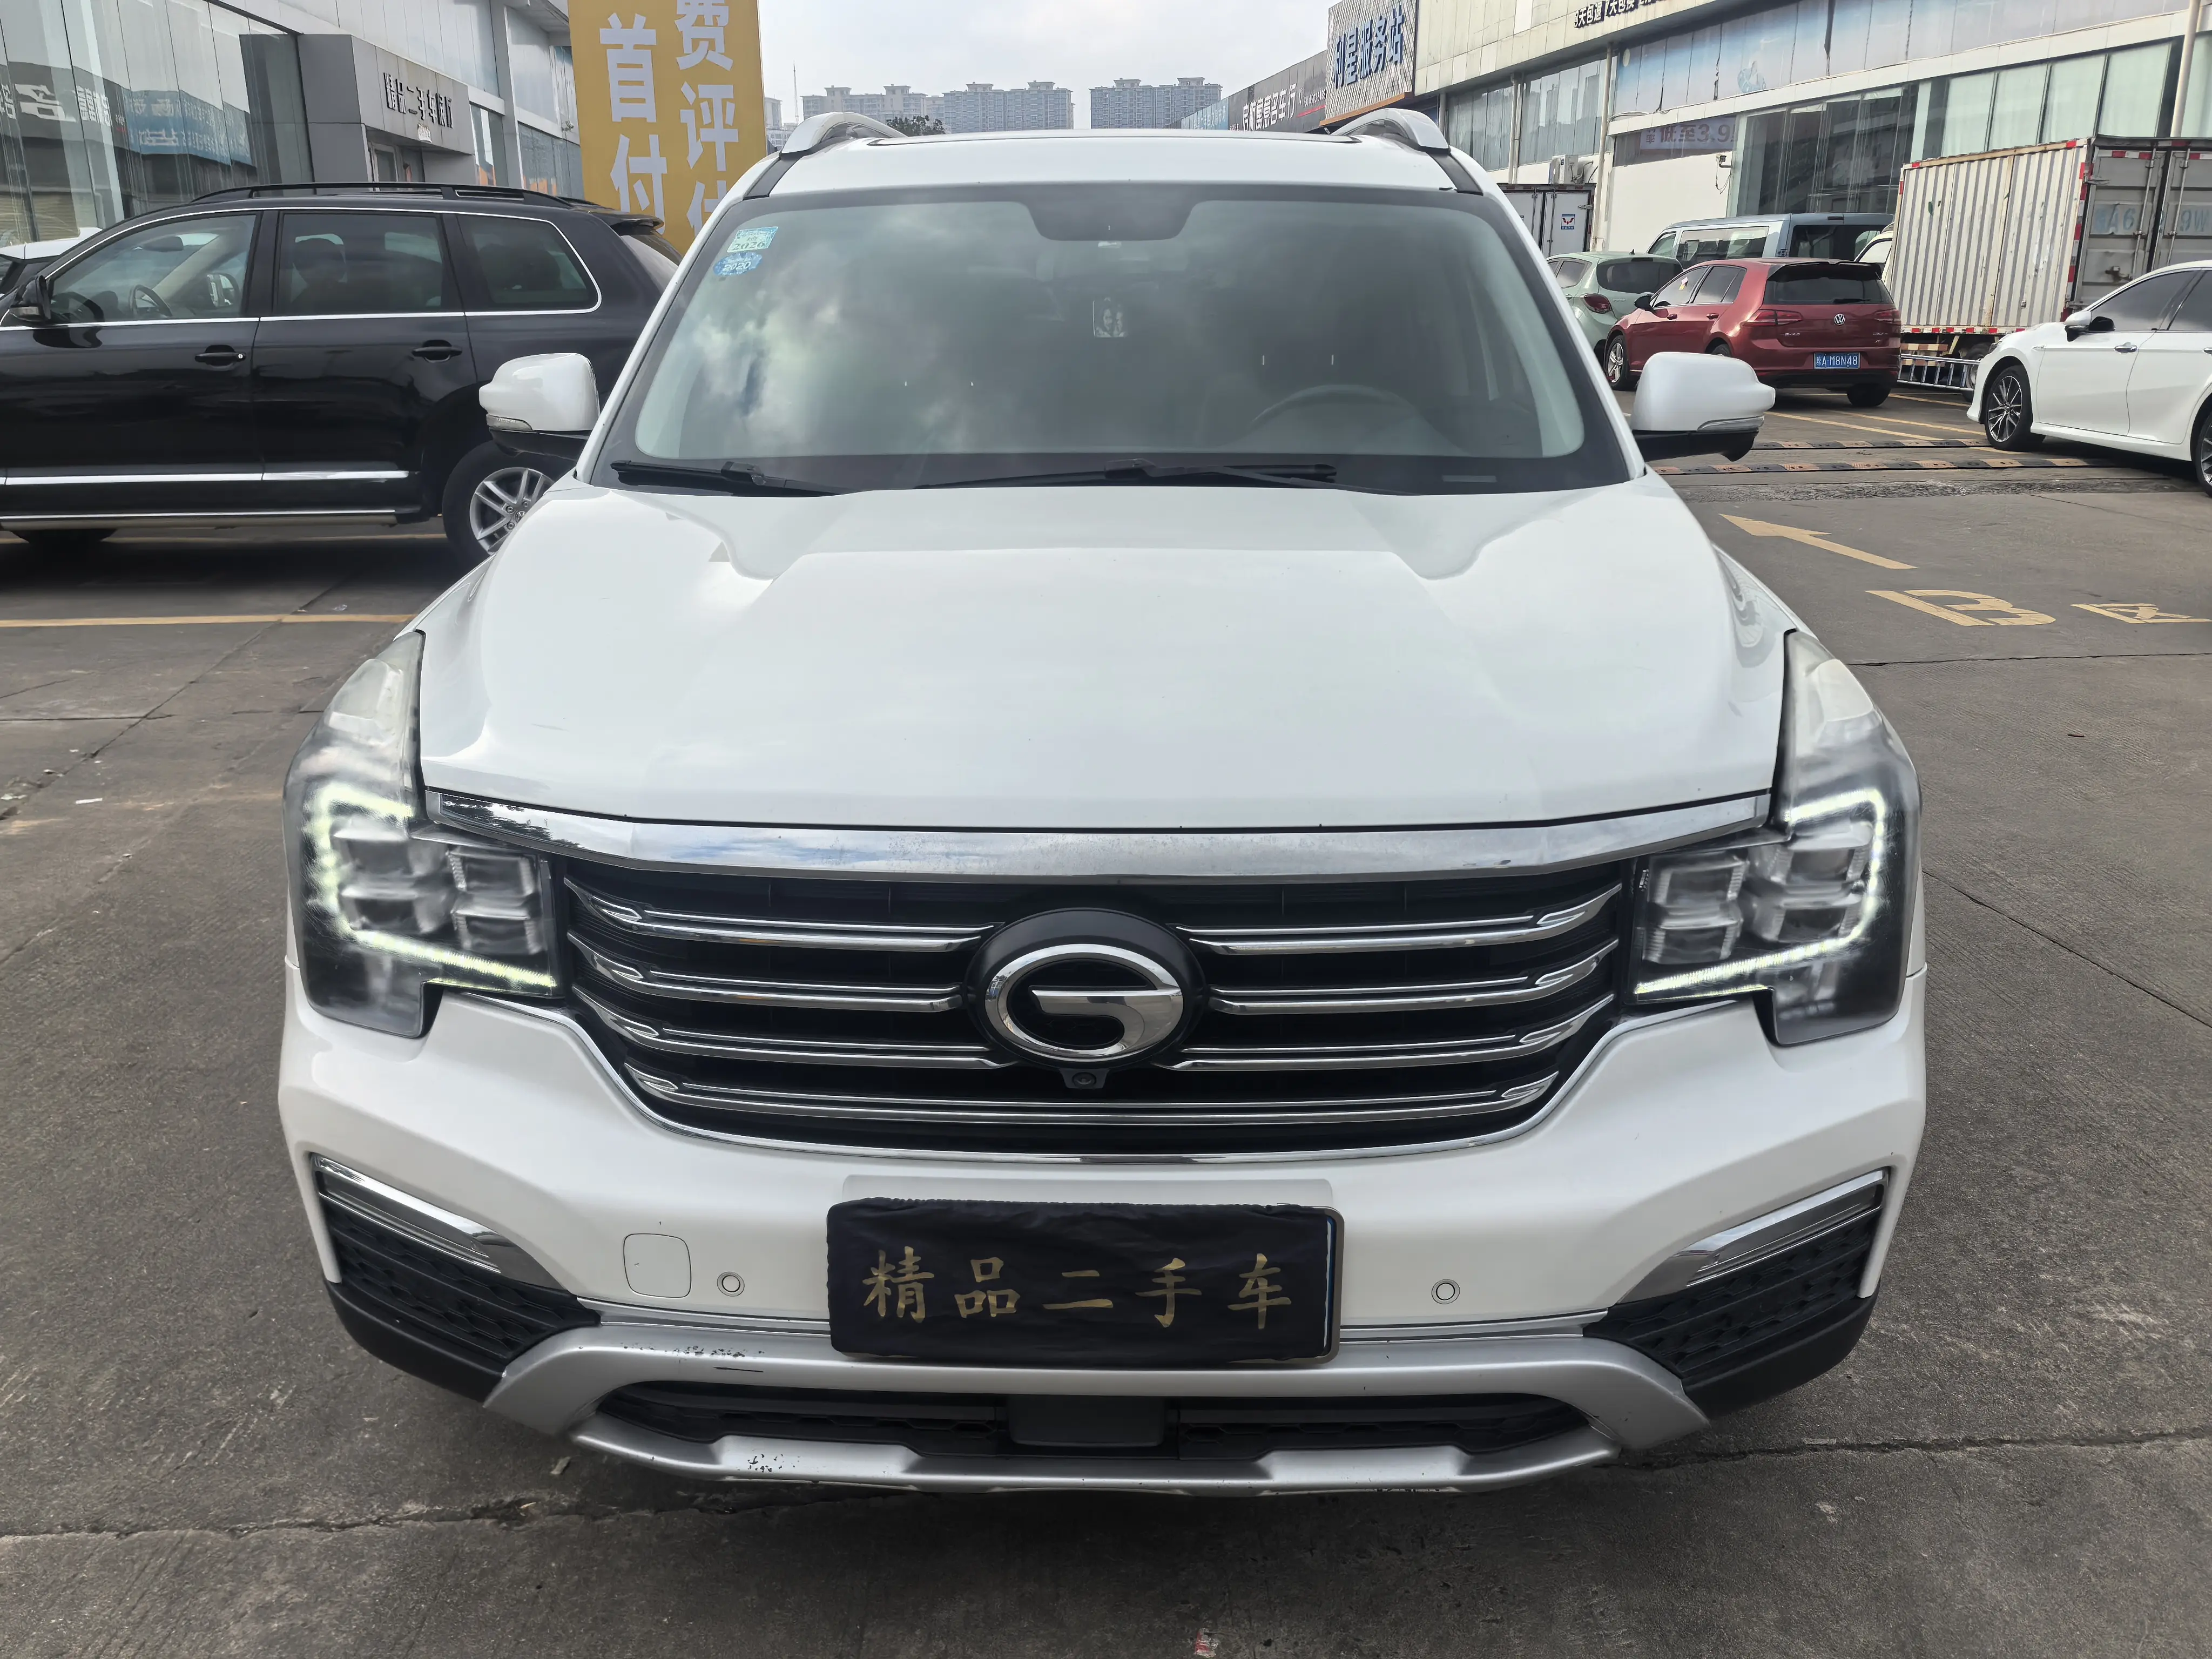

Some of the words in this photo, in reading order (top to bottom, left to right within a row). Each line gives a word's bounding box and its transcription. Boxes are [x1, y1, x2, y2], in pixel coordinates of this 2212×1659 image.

[599, 12, 667, 234] 首付
[722, 261, 751, 271] 2020
[862, 1245, 1291, 1329] 精品二手车
